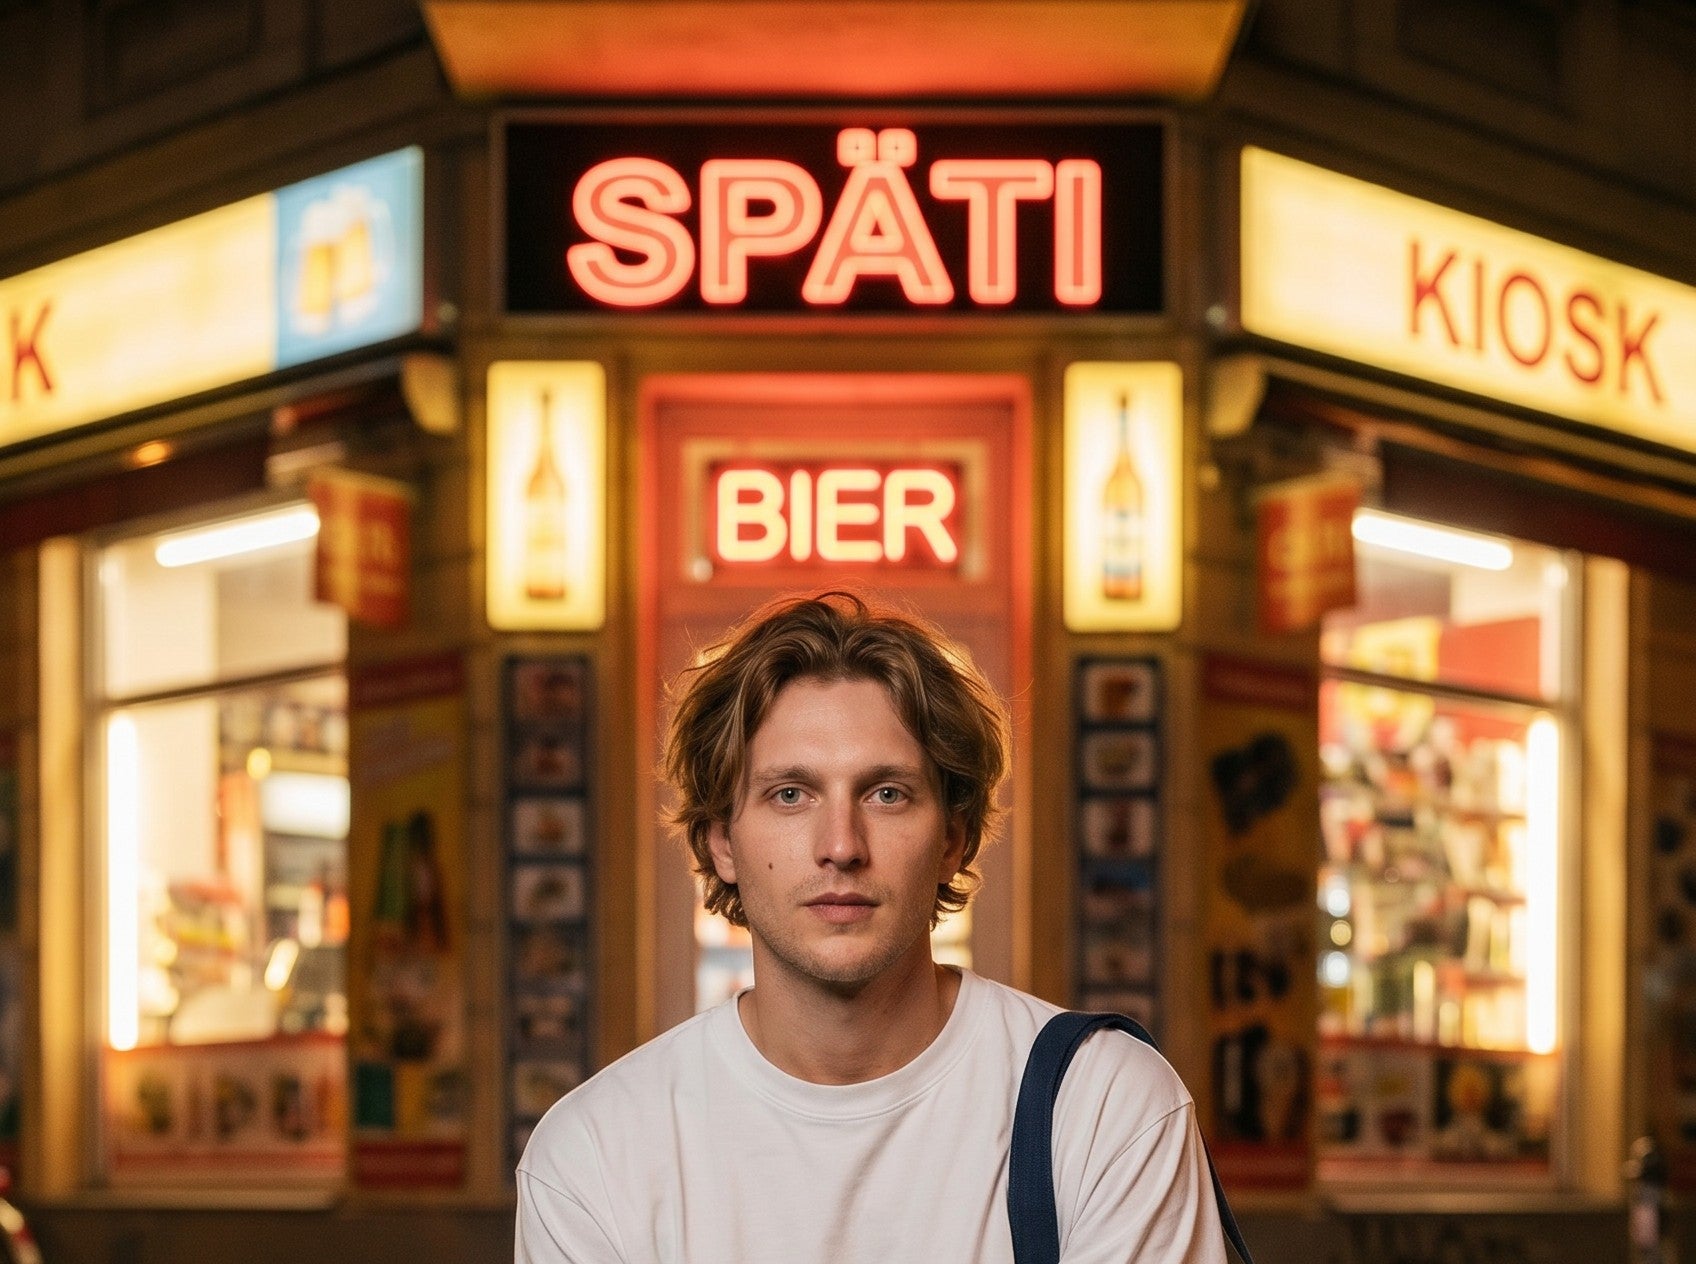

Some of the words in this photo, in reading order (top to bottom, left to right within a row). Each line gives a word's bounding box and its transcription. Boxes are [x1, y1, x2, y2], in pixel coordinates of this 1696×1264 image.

[567, 127, 1102, 306] SPÄTI
[9, 302, 54, 402] K
[1408, 239, 1663, 405] KIOSK
[716, 468, 958, 563] BIER
